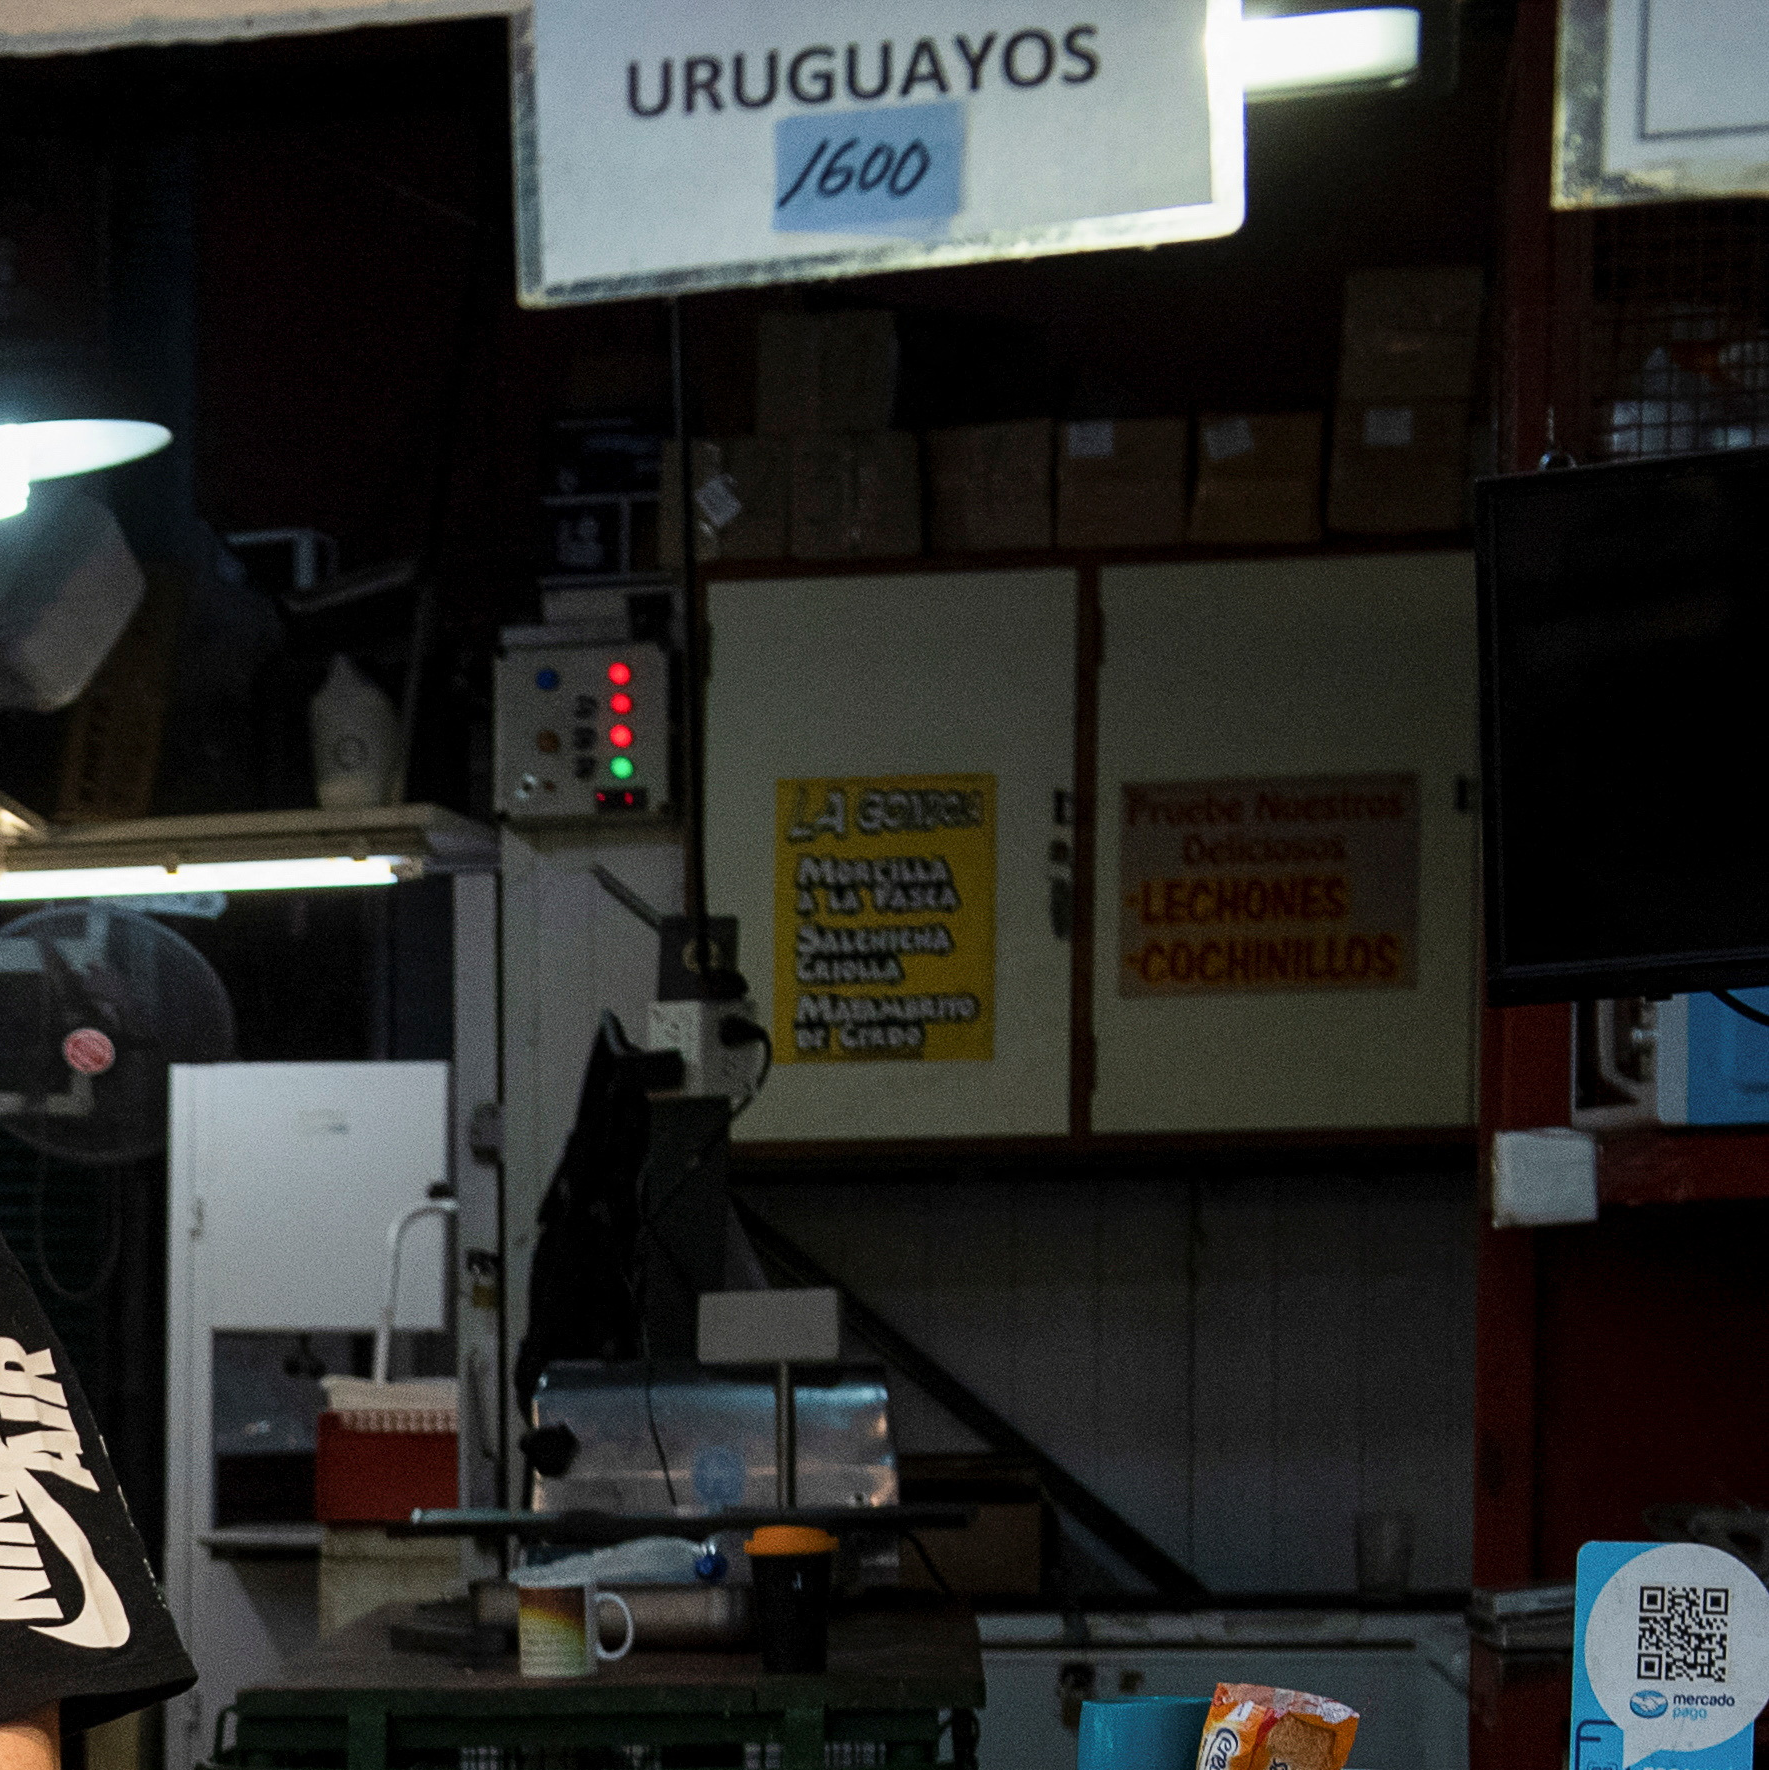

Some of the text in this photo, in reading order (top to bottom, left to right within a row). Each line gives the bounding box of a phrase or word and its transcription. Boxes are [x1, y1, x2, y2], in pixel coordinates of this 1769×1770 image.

[627, 23, 1100, 118] URUGUAYOS
[776, 137, 931, 209] 1600
[1140, 876, 1347, 924] LECHONES
[1139, 930, 1399, 984] COCHINILLOS
[1672, 1708, 1708, 1721] pago
[1673, 1693, 1735, 1707] mercado
